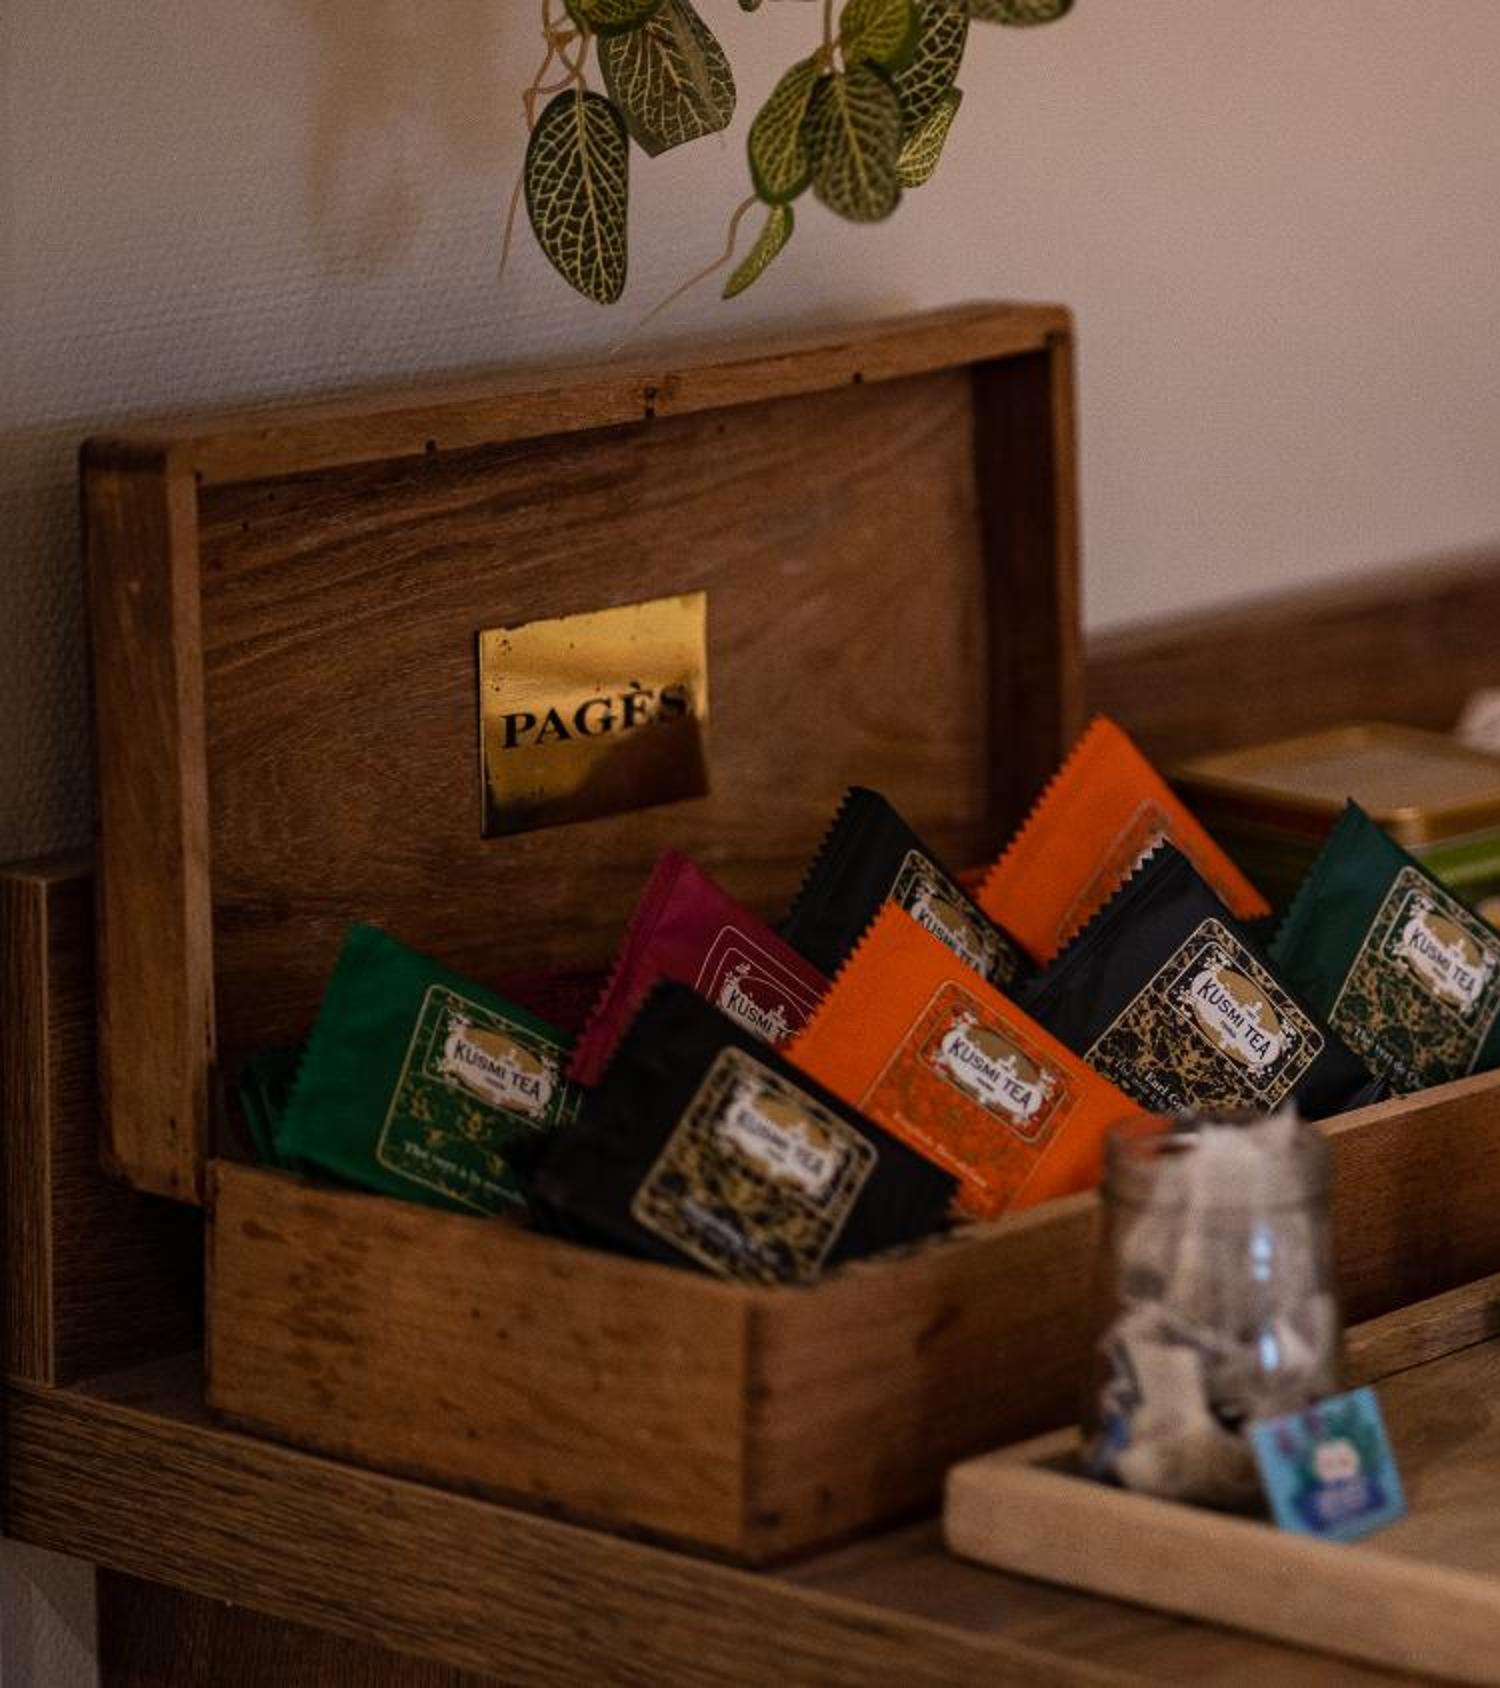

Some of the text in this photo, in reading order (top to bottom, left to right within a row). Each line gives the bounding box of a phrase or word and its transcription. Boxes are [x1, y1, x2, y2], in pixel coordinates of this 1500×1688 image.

[500, 682, 687, 748] PAGÈS
[1409, 927, 1476, 995] KUSMI TEA
[727, 989, 773, 1031] KUSMI
[1196, 977, 1271, 1060] KUSMI TEA
[453, 1039, 541, 1101] KUSMI TEA
[948, 1037, 1032, 1110] KUSMI TEA
[736, 1109, 824, 1176] KUSMI TEA
